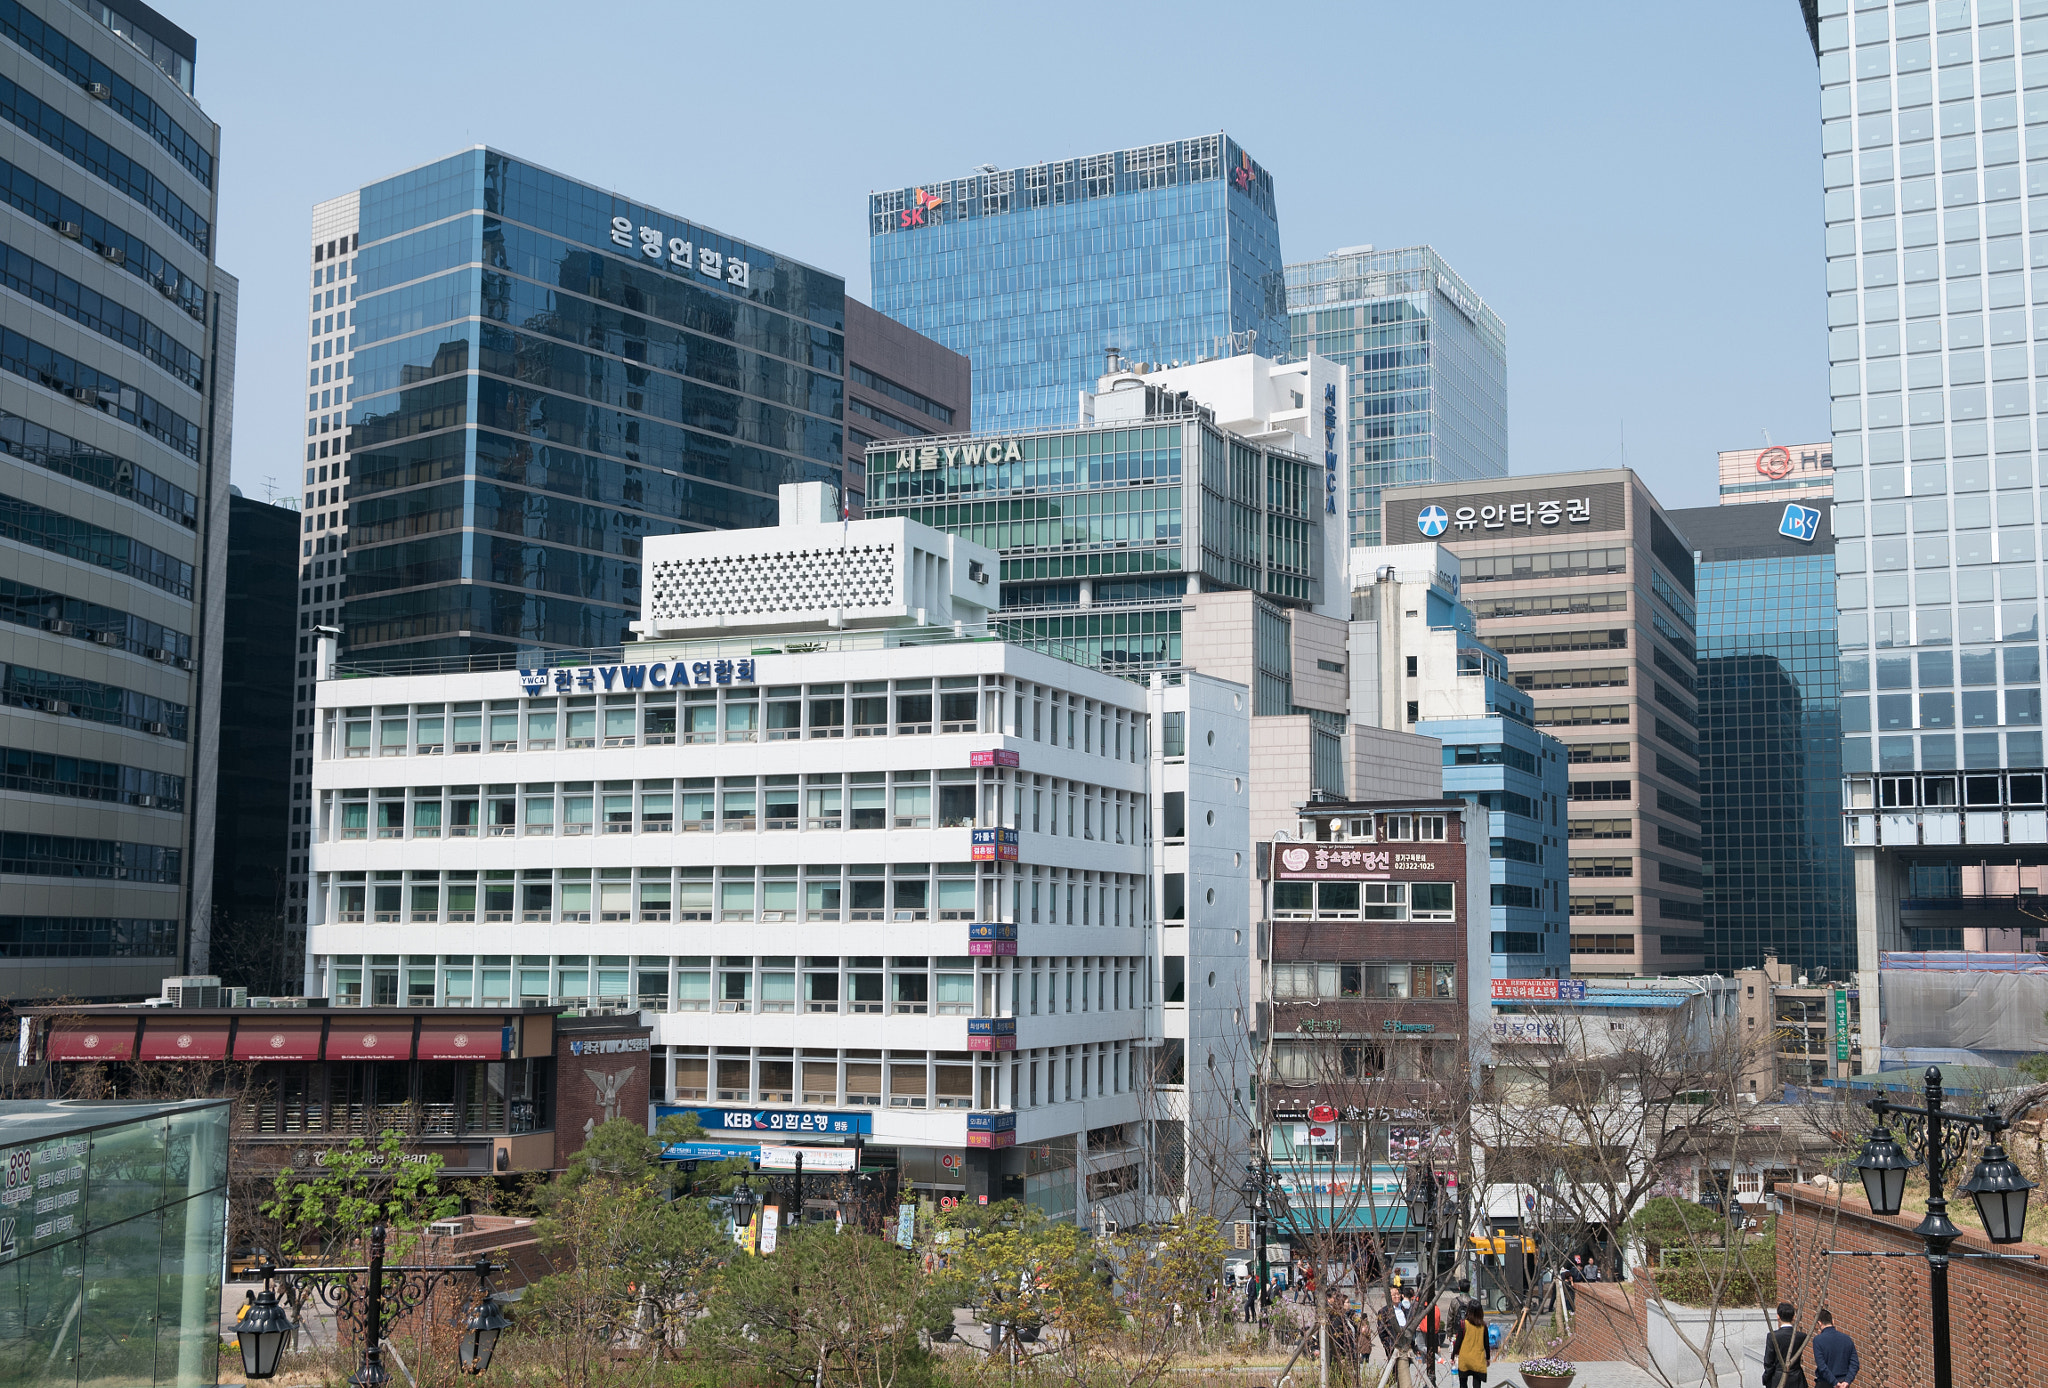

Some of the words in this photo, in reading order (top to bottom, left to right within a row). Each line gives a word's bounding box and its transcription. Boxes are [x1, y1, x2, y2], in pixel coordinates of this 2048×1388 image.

[901, 207, 925, 227] SK
[611, 216, 749, 289] 은행연합회
[896, 441, 1022, 472] 서울YWCA
[1324, 383, 1338, 514] 서울YWCA
[1454, 497, 1591, 532] 유안타증권
[521, 677, 545, 685] YWCA
[554, 659, 755, 693] 한국YWCA연합회
[1362, 852, 1389, 870] 당신
[1394, 862, 1435, 870] 02)322-1025
[1527, 986, 1557, 998] 레스토랑
[724, 1112, 752, 1128] KEB
[770, 1114, 828, 1131] 외환은행
[834, 1121, 848, 1131] 명동
[942, 1154, 962, 1177] 약
